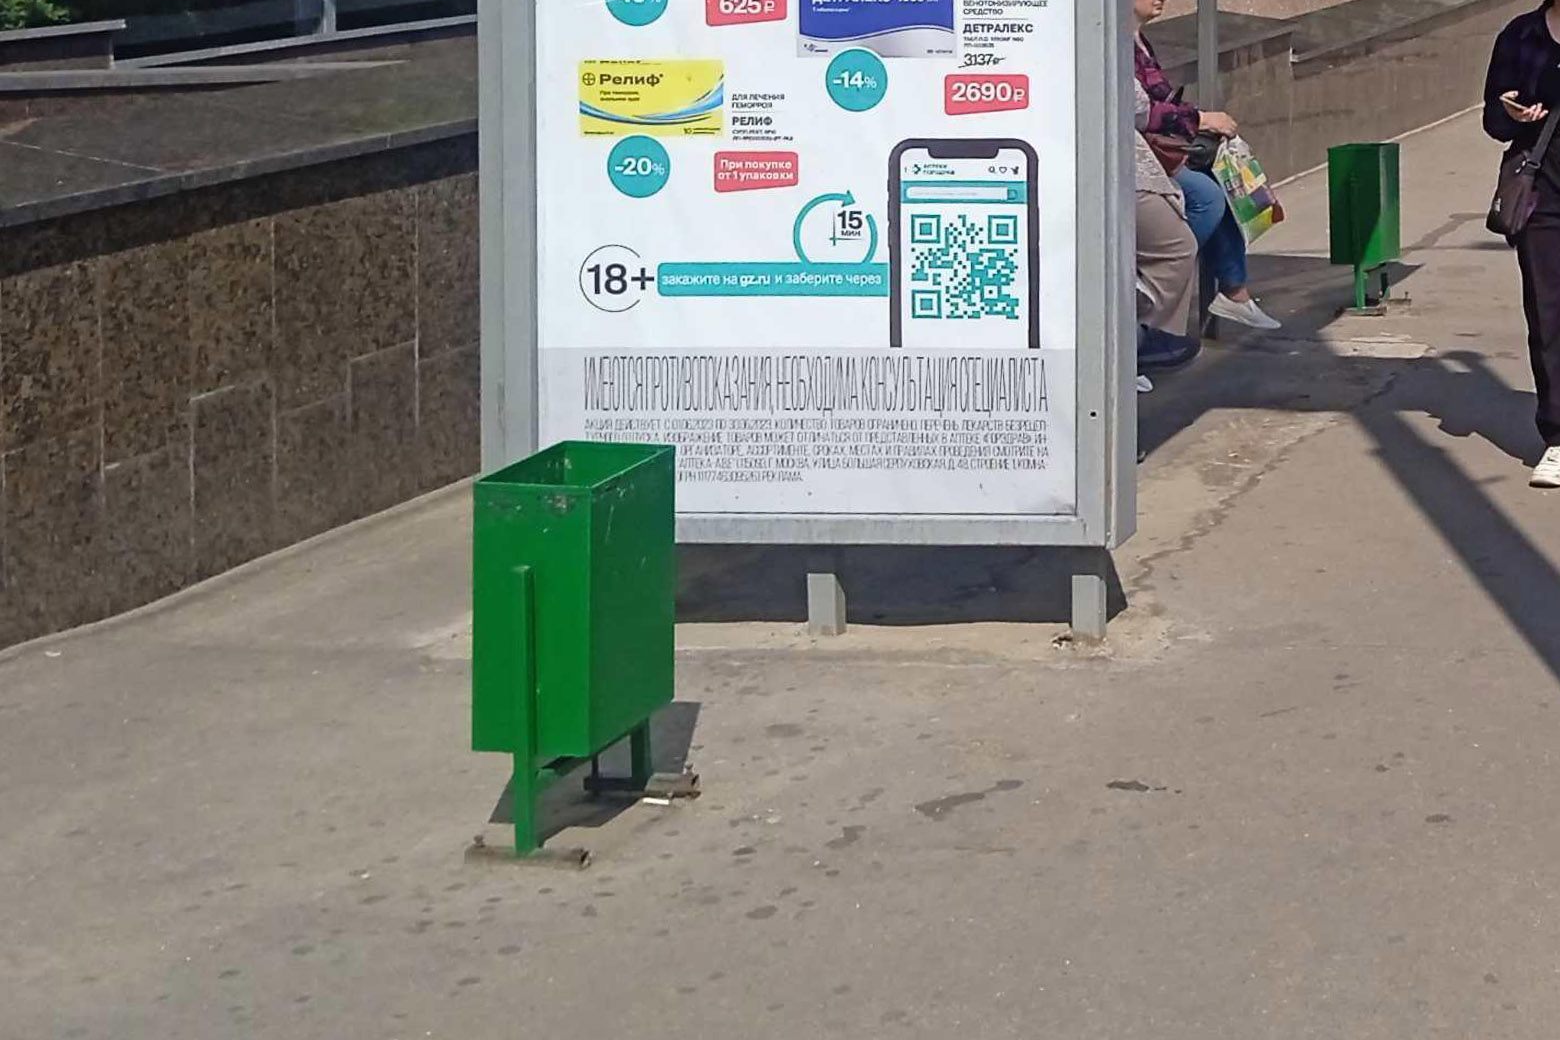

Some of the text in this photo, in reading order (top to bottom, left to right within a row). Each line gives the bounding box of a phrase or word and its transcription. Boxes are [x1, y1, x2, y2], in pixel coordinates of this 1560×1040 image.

[963, 23, 1034, 34] ДЕТРАЛЕКС
[732, 116, 773, 126] РЕЛИФ
[720, 159, 792, 172] При покупке
[717, 171, 793, 182] от 1 упаковки
[838, 210, 863, 229] 15
[586, 263, 655, 296] 18+
[661, 273, 721, 287] закажите
[723, 275, 738, 285] на
[775, 275, 783, 284] и
[785, 271, 843, 286] заберите
[846, 275, 881, 288] через
[584, 356, 643, 411] ИМЕЮТСЯ
[776, 356, 858, 418] НЕОБХОДИМА
[861, 356, 957, 418] КОНСУЛЬТАЦИЯ
